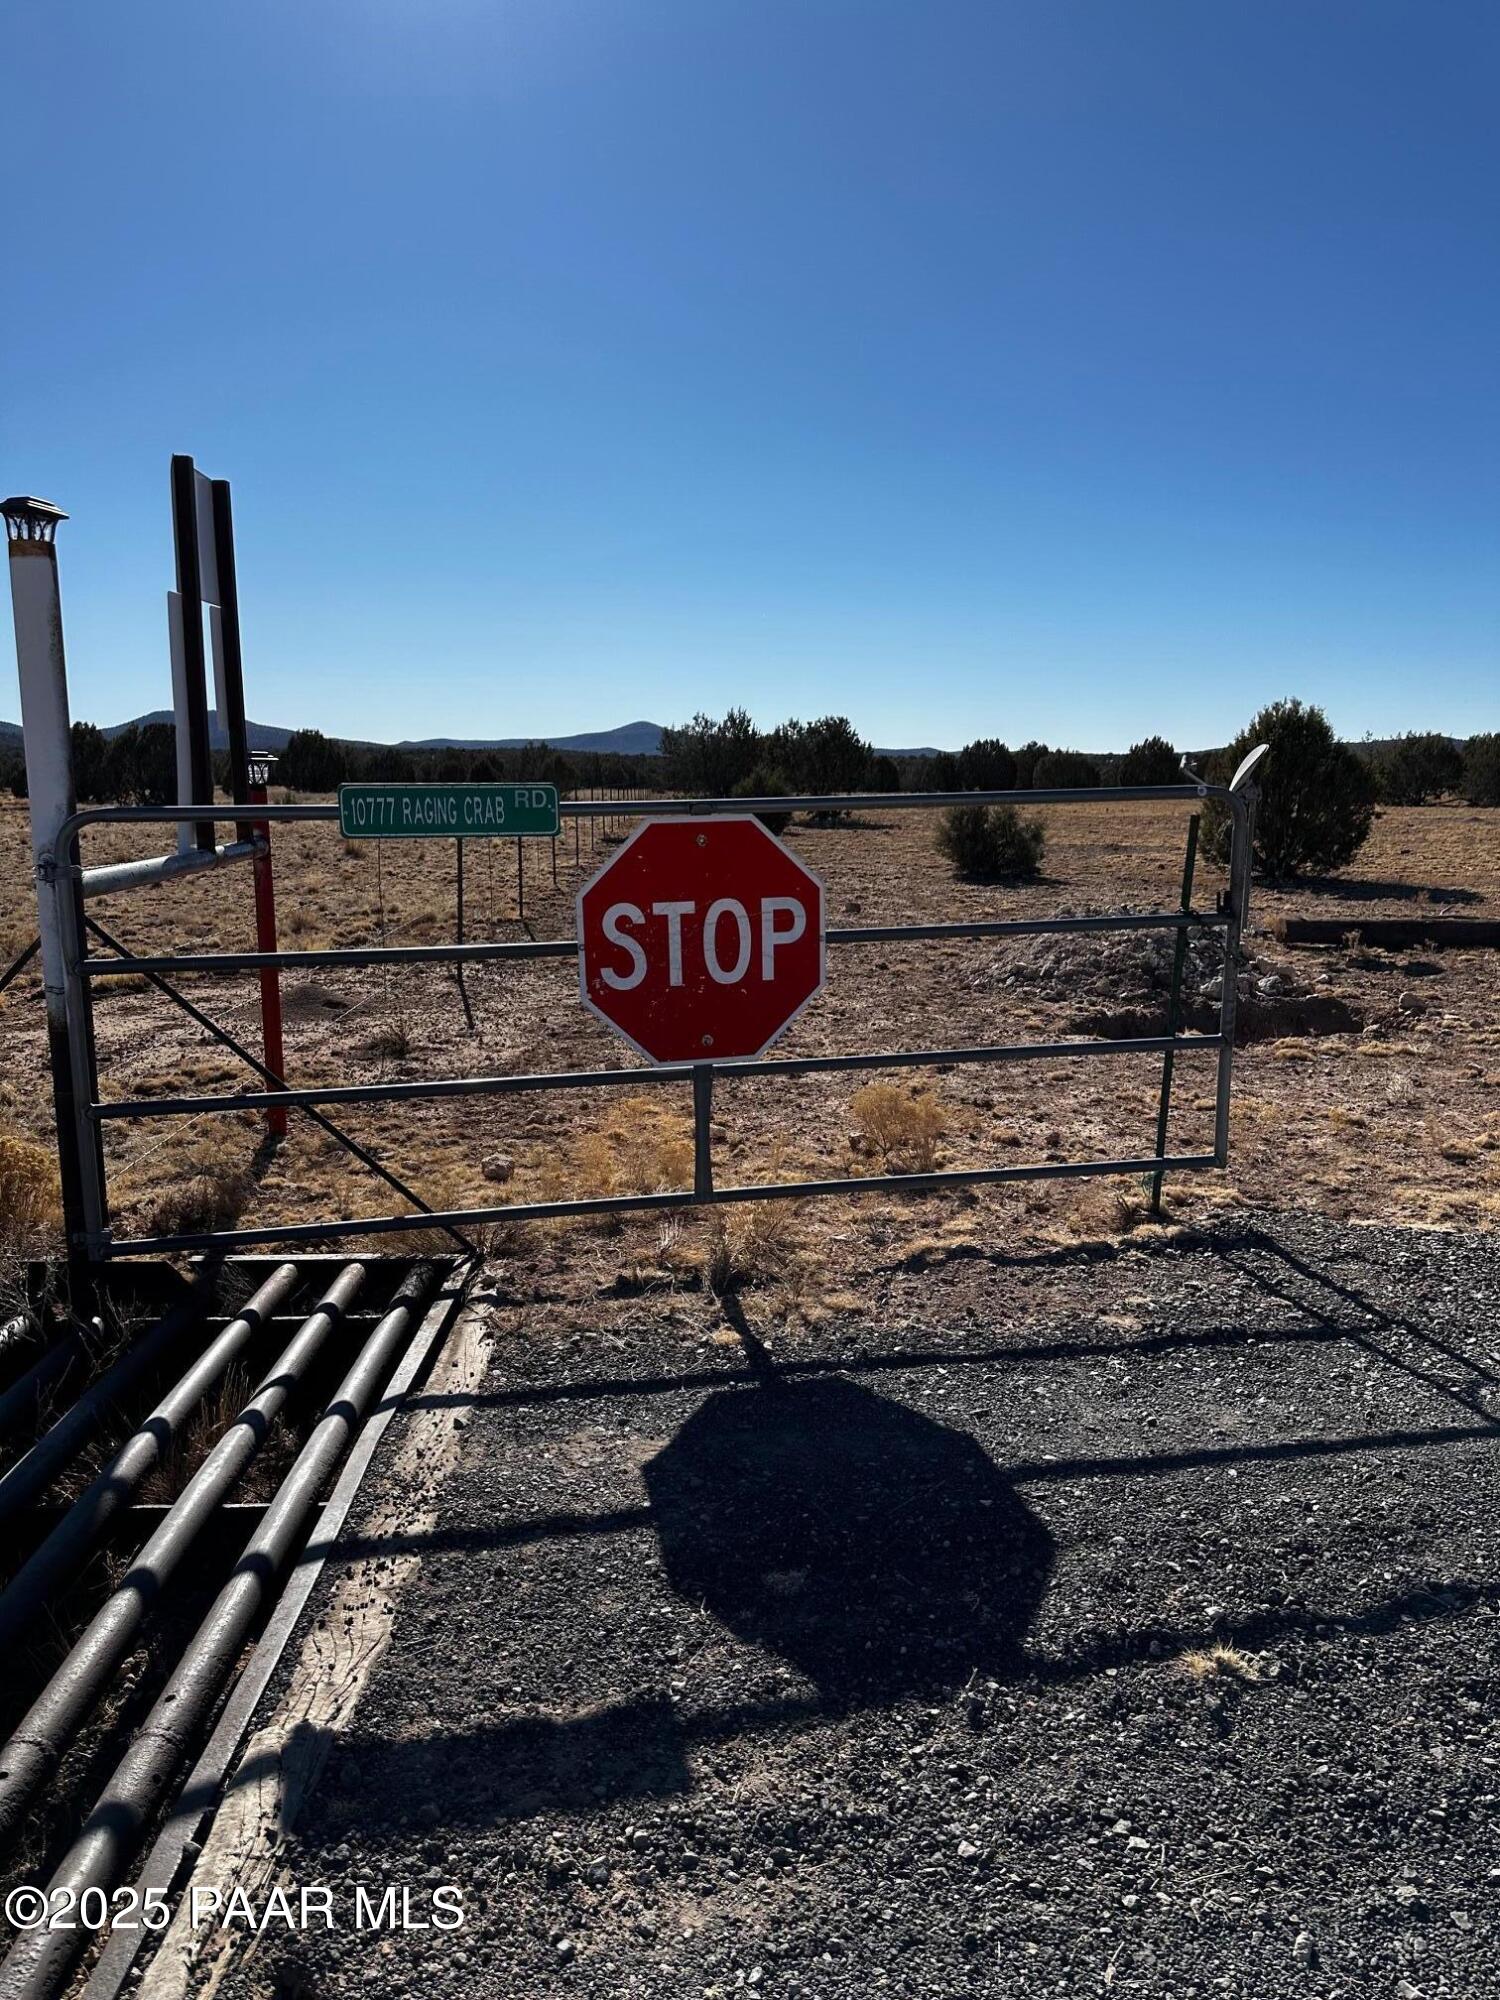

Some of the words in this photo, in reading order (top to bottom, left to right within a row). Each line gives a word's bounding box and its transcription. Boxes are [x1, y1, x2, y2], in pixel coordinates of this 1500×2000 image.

[351, 797, 395, 825] 10777
[402, 797, 457, 824] RAGING
[463, 796, 505, 824] CRAB
[600, 896, 807, 991] STOP
